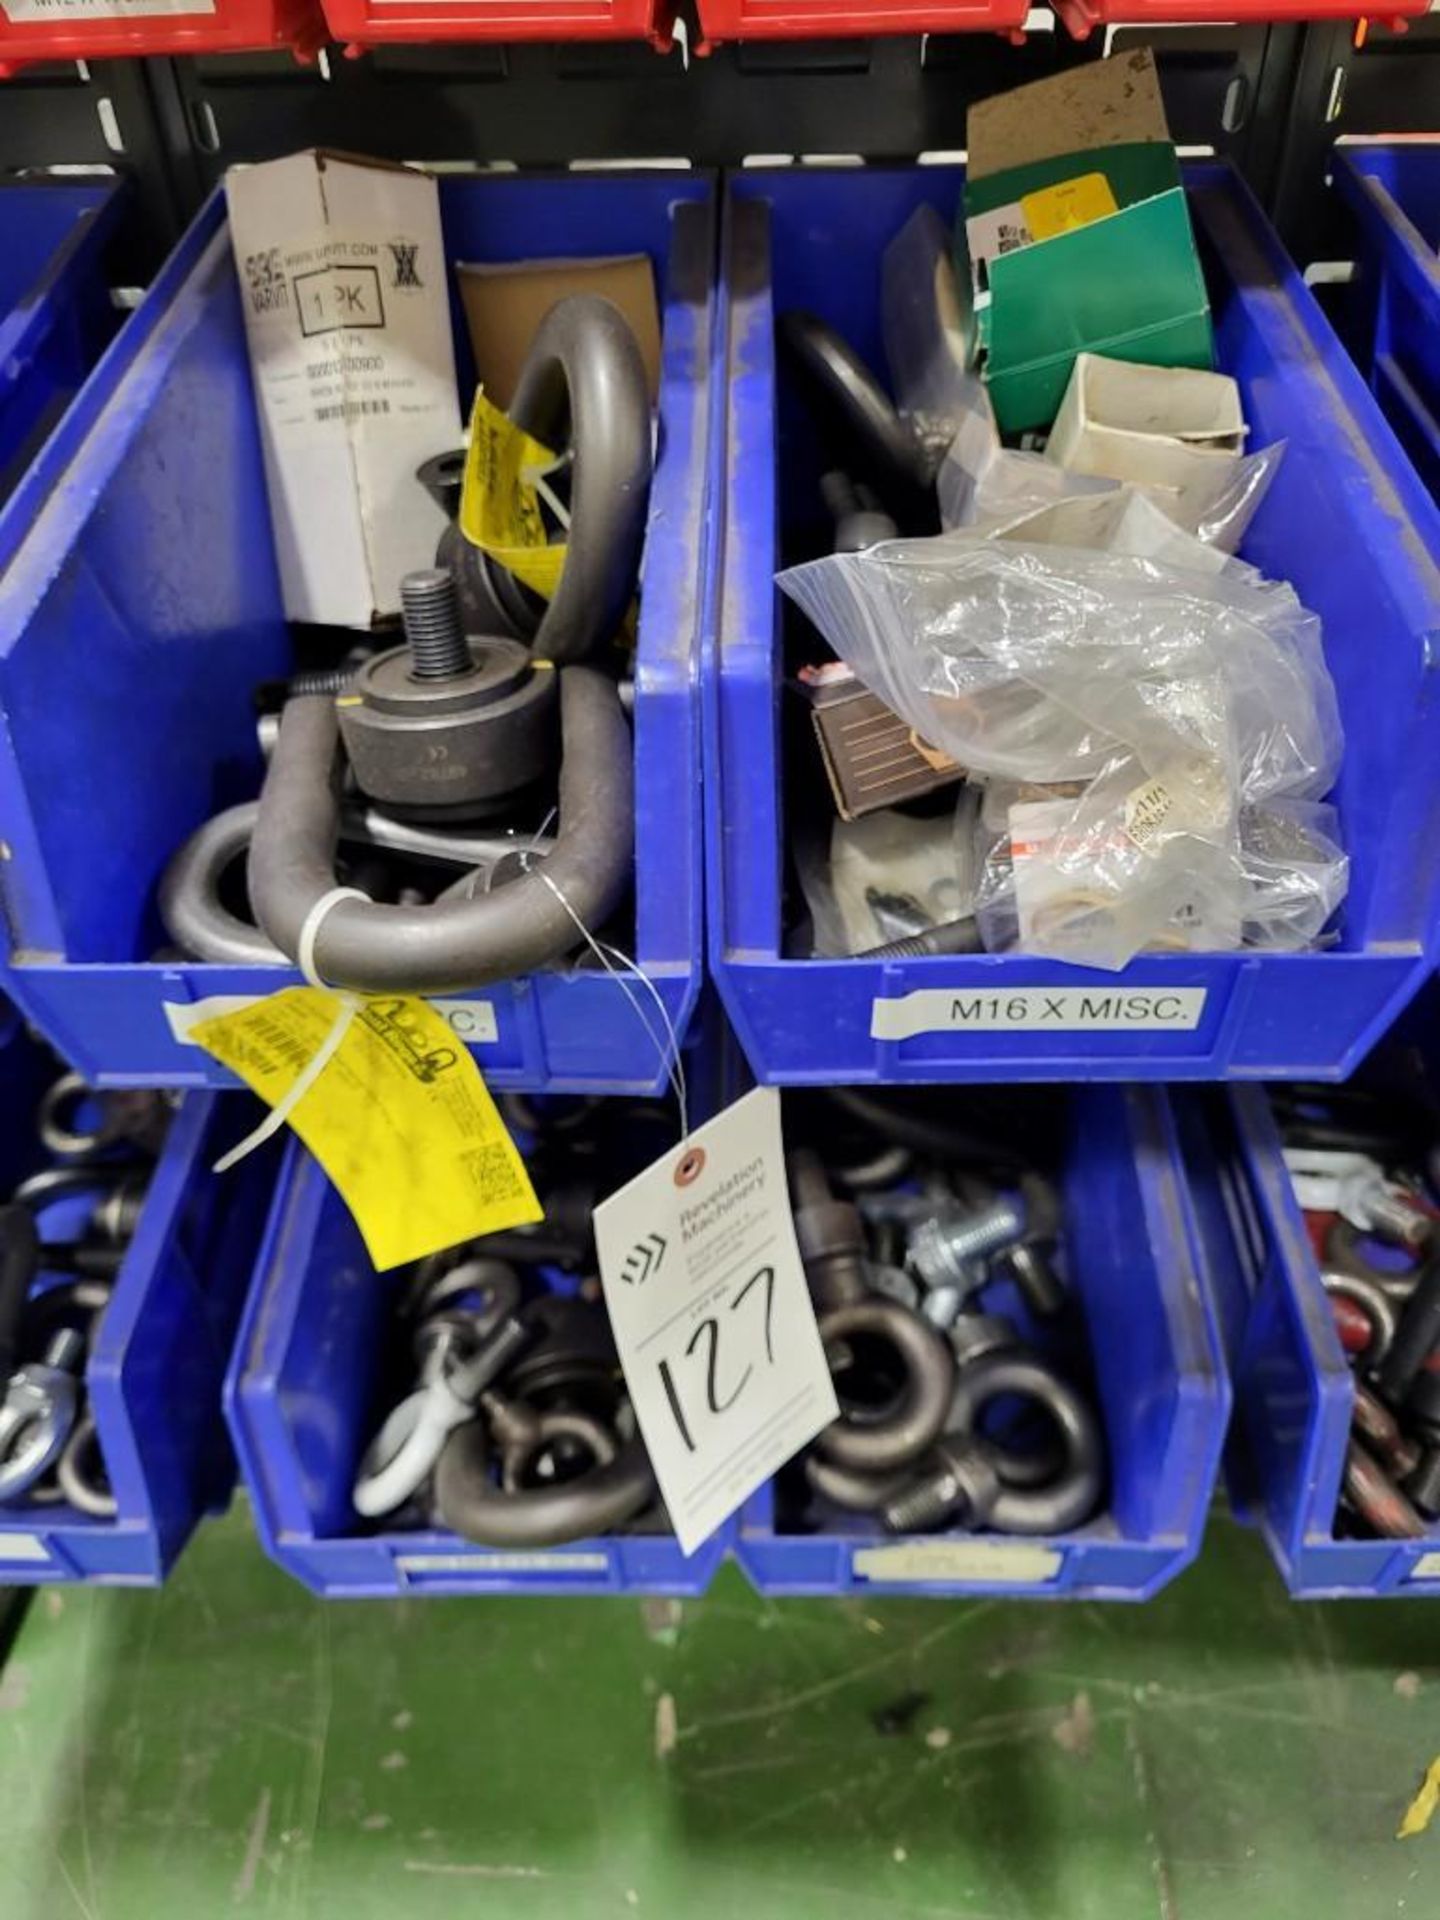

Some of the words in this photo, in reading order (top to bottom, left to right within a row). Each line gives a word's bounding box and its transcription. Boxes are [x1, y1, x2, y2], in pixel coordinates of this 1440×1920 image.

[951, 999, 1029, 1021] M16
[1040, 998, 1066, 1019] X
[1079, 997, 1189, 1020] MISC.
[679, 1157, 765, 1228] Revelation
[681, 1174, 767, 1244] Machinery
[657, 1265, 775, 1453] 127
